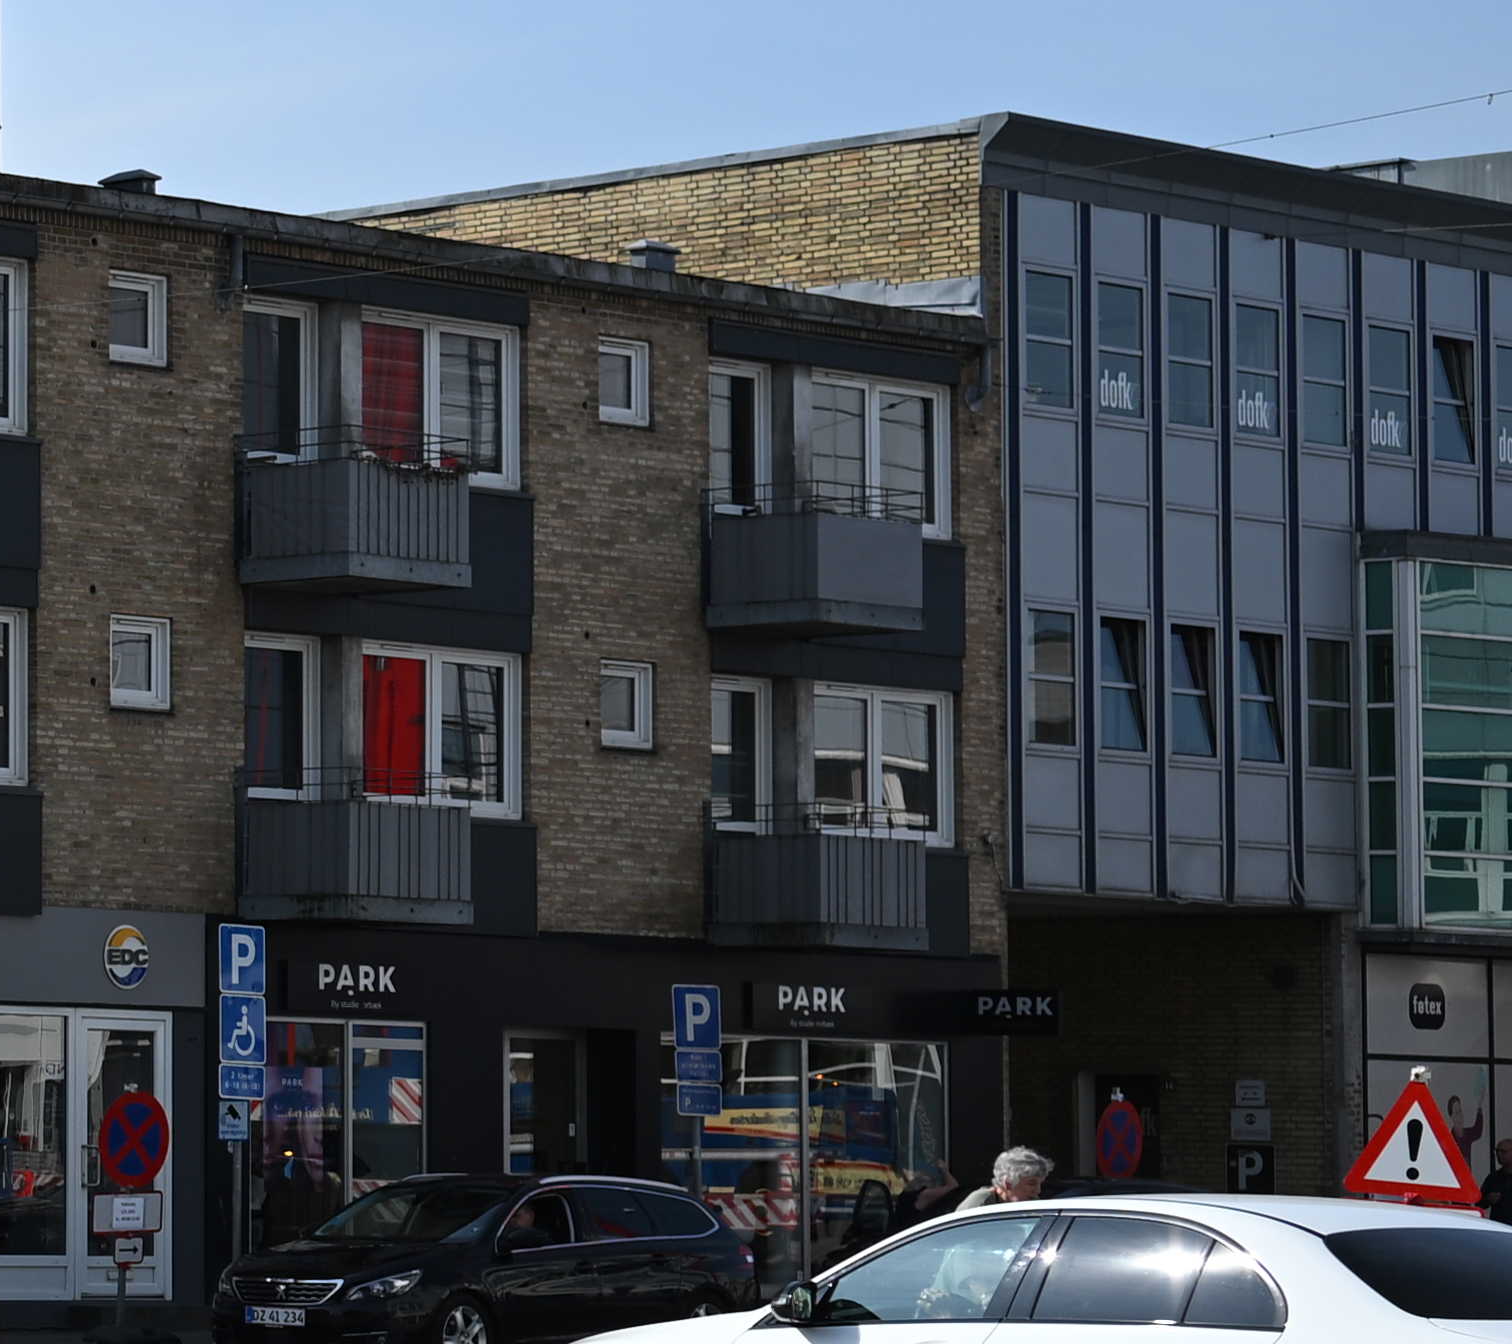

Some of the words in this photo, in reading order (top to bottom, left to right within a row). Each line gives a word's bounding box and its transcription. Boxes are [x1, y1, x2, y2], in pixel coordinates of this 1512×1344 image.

[1100, 369, 1134, 410] dofk
[1238, 390, 1269, 429] dofk
[1370, 408, 1401, 448] dofk
[1498, 427, 1512, 464] do
[107, 948, 149, 965] EDC
[231, 933, 256, 984] P
[319, 963, 397, 993] PARK
[685, 993, 711, 1042] P
[778, 986, 846, 1014] PARK
[977, 996, 1053, 1016] PARK
[1413, 995, 1442, 1015] føtex
[281, 1077, 304, 1088] PARK
[1238, 1151, 1264, 1191] P
